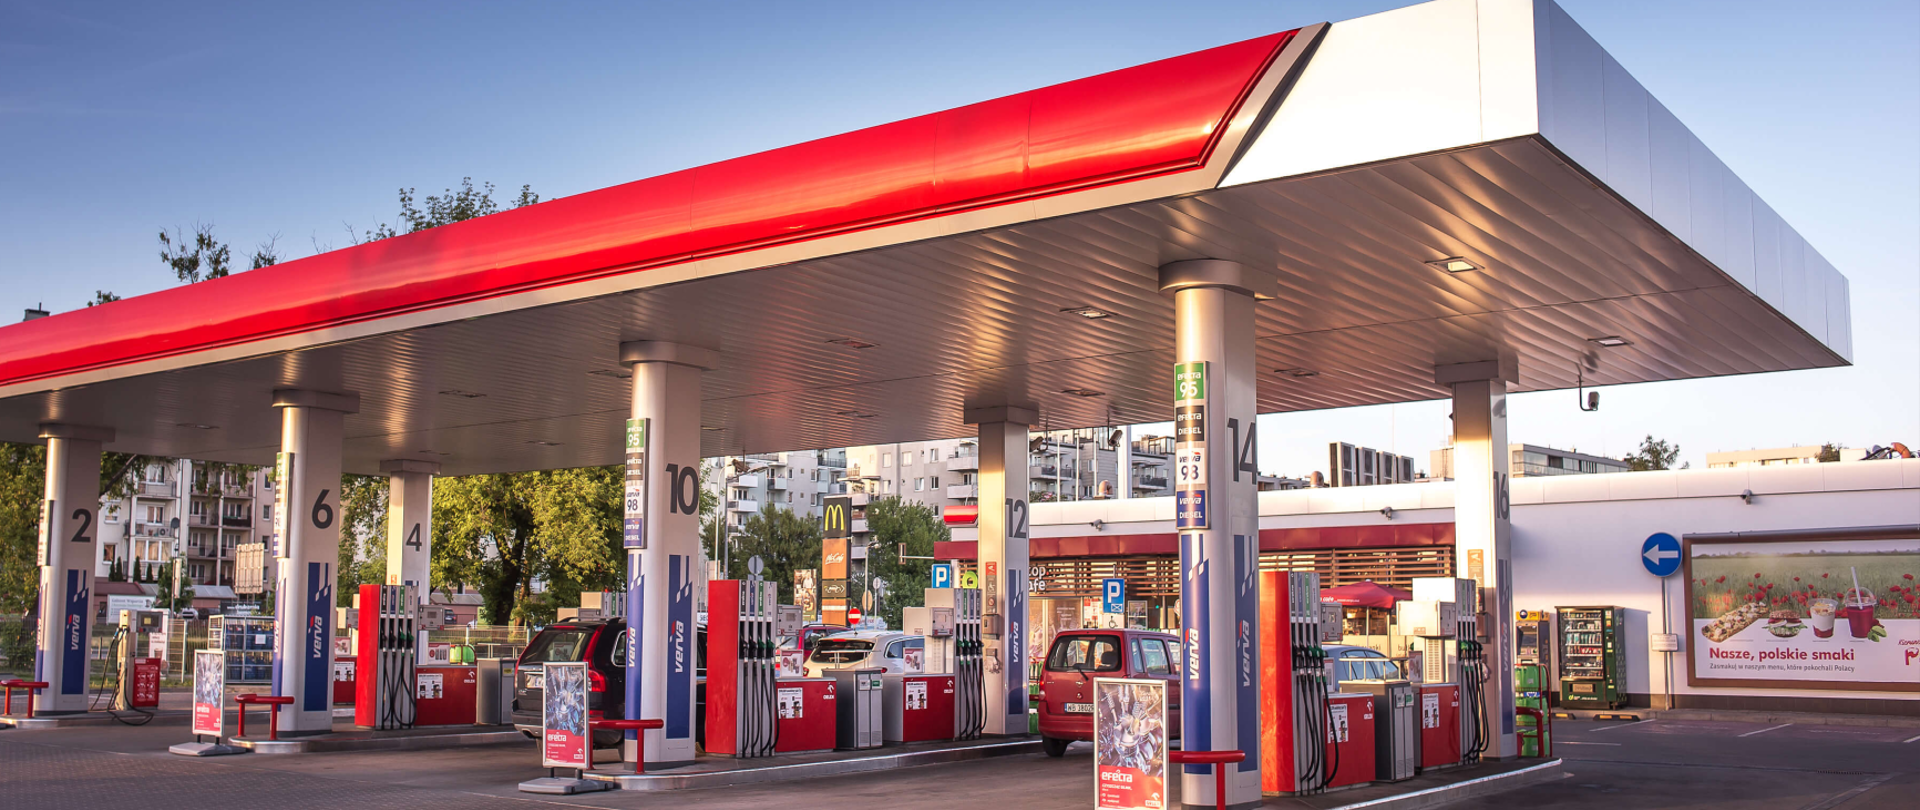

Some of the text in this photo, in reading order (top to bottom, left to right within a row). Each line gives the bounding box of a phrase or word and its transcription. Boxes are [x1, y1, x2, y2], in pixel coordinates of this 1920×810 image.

[1180, 381, 1198, 397] 95
[628, 434, 640, 446] 95
[1178, 427, 1202, 435] DIESEL
[1227, 417, 1258, 486] 14
[1181, 464, 1199, 480] 98
[665, 463, 699, 515] 10
[1179, 497, 1202, 505] verva
[1493, 471, 1510, 520] 16
[312, 489, 334, 530] 6
[626, 499, 638, 512] 98
[1005, 498, 1027, 539] 12
[71, 508, 92, 543] 2
[406, 523, 422, 552] 4
[935, 567, 947, 588] P
[1107, 581, 1121, 604] P
[71, 614, 80, 651] verva
[313, 615, 323, 659] verva
[675, 620, 684, 673] verva
[1189, 627, 1200, 680] verva
[1242, 619, 1251, 687] verva
[1709, 647, 1855, 662] Nasze, polskie smaki
[1709, 662, 1737, 670] Zasmakuj
[1834, 664, 1855, 673] Polacy
[1101, 769, 1133, 783] efecta
